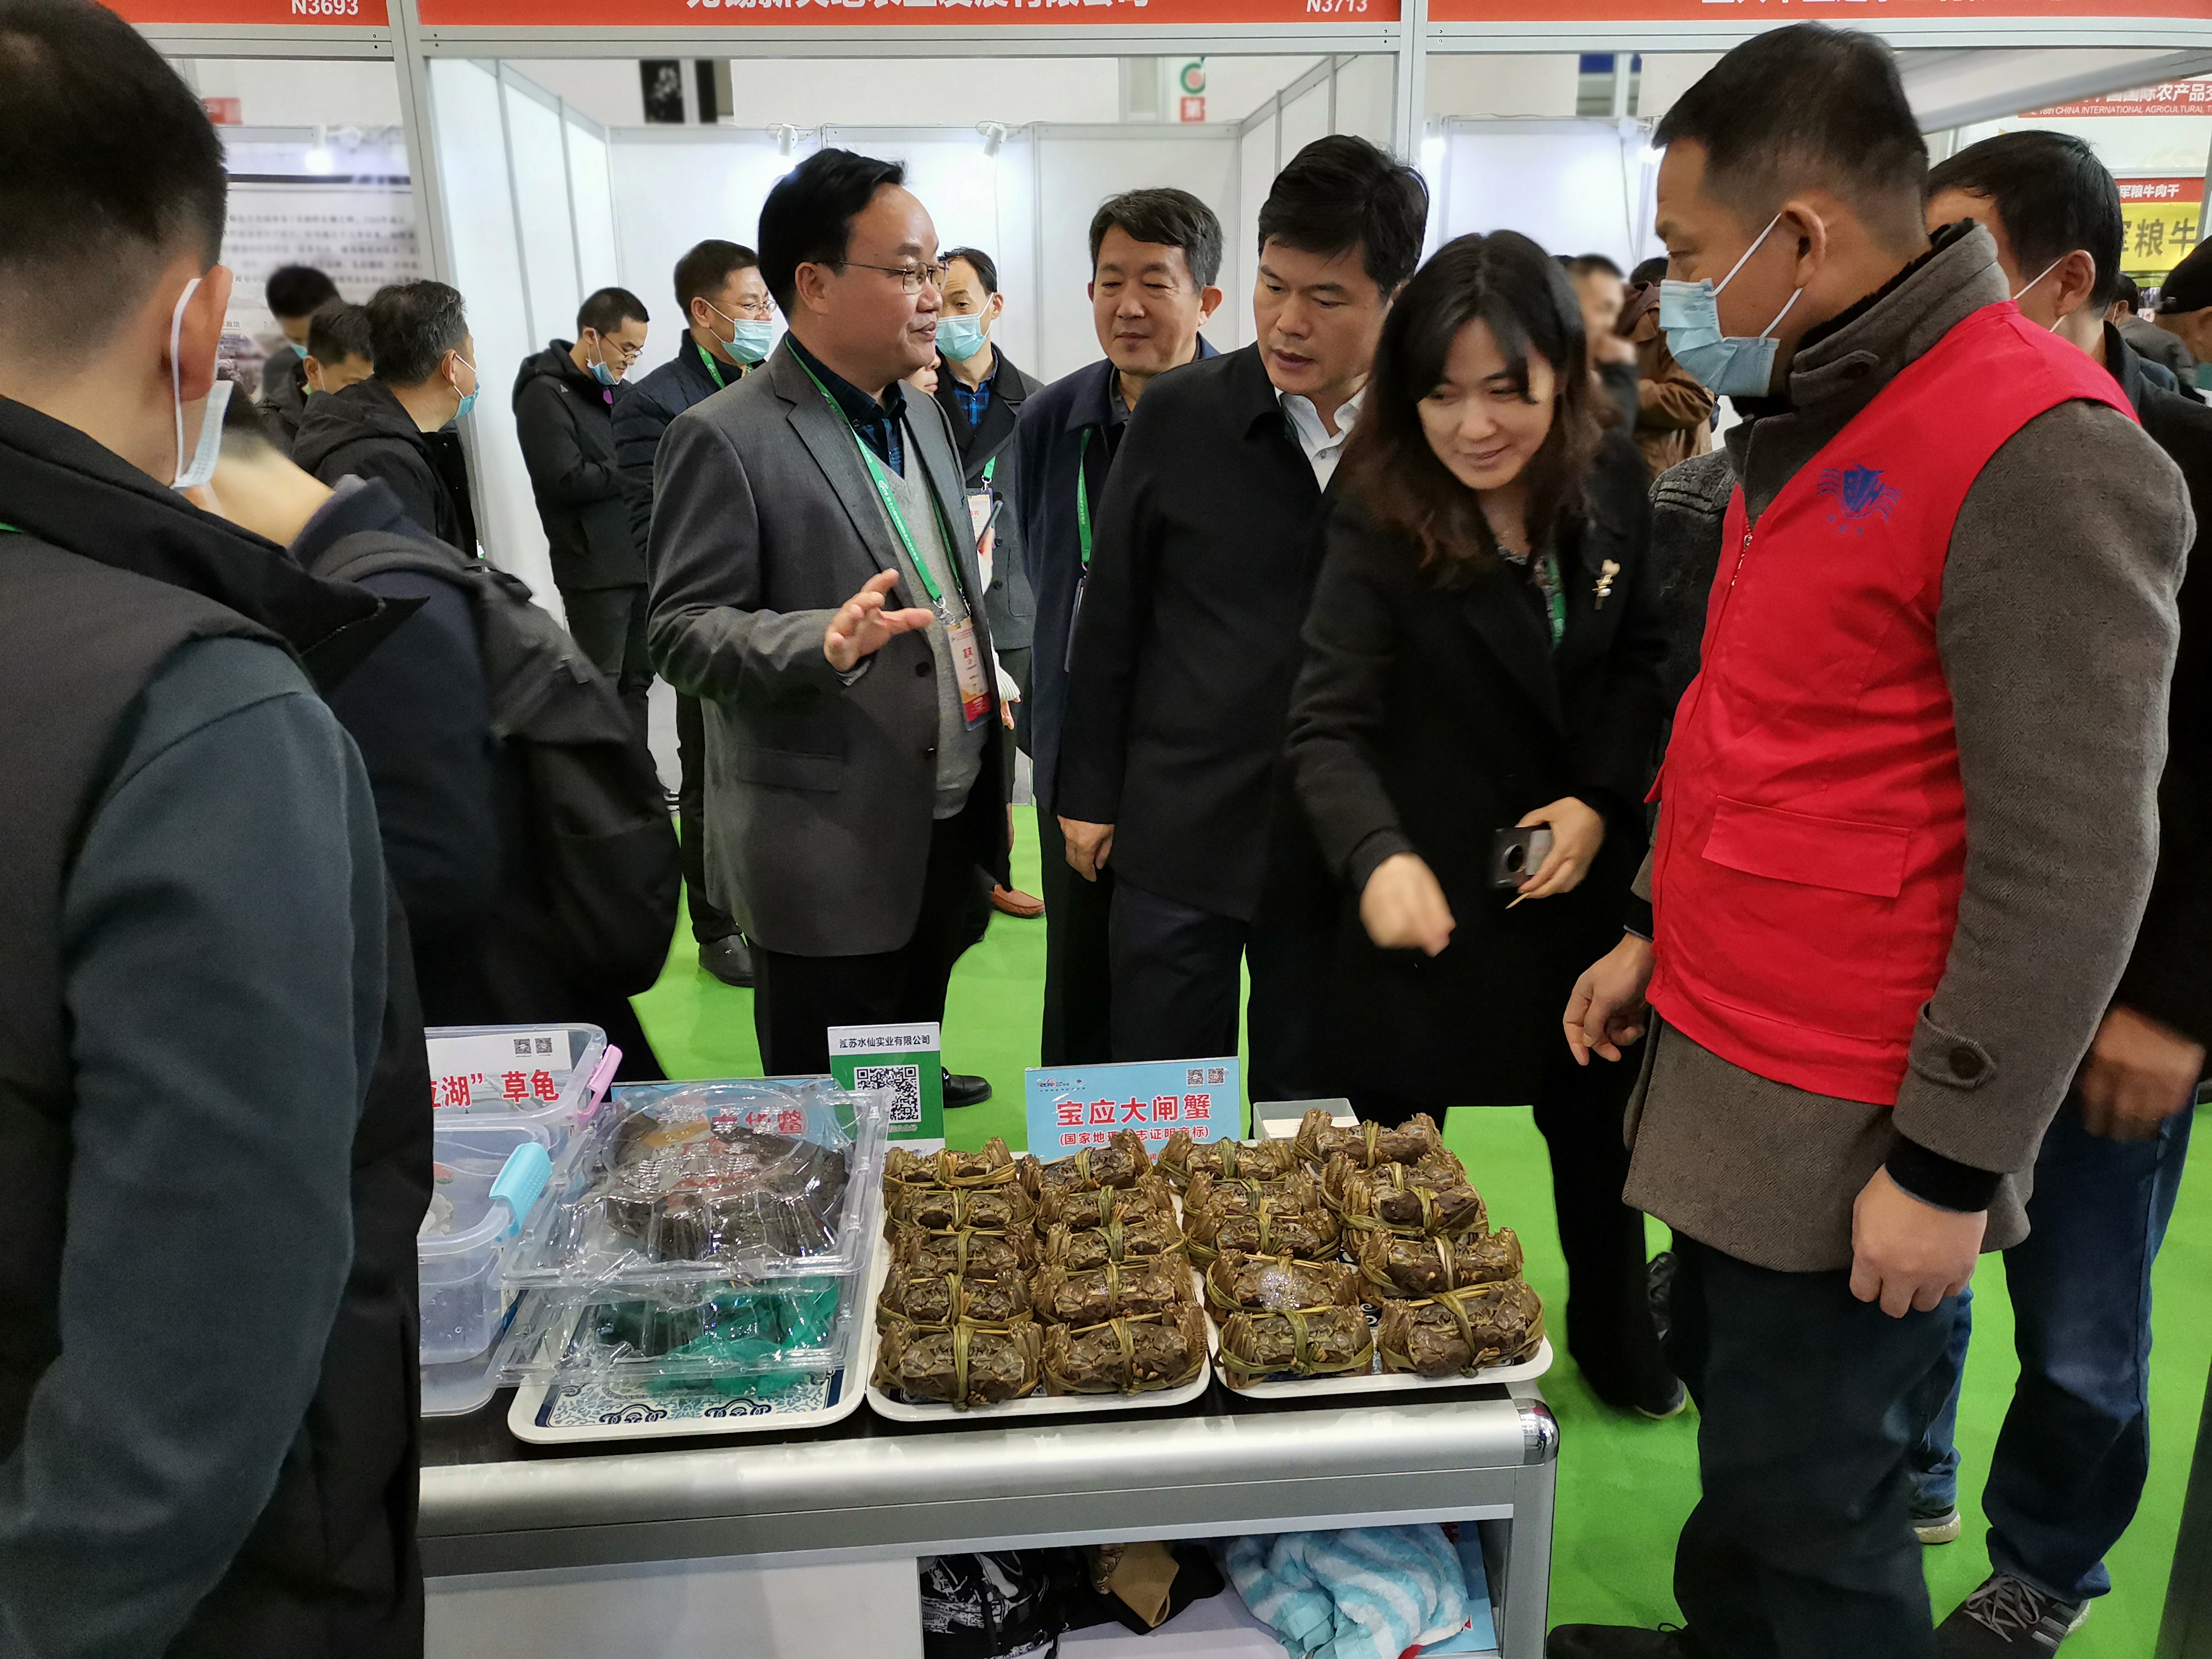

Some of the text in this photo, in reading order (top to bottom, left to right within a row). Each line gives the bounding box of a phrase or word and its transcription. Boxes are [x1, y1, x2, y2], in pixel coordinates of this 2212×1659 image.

[291, 0, 358, 15] N3693
[1306, 0, 1368, 12] N3713
[2081, 105, 2143, 114] INTERNATIONAL
[2145, 105, 2204, 114] AGRICULTURAL
[2119, 184, 2179, 199] 军粮牛肉干
[839, 1035, 930, 1048] 江苏水仙实业有限公司
[1056, 1093, 1211, 1126] 宝应大闸蟹
[1060, 1126, 1209, 1146] (国家地志证明标)
